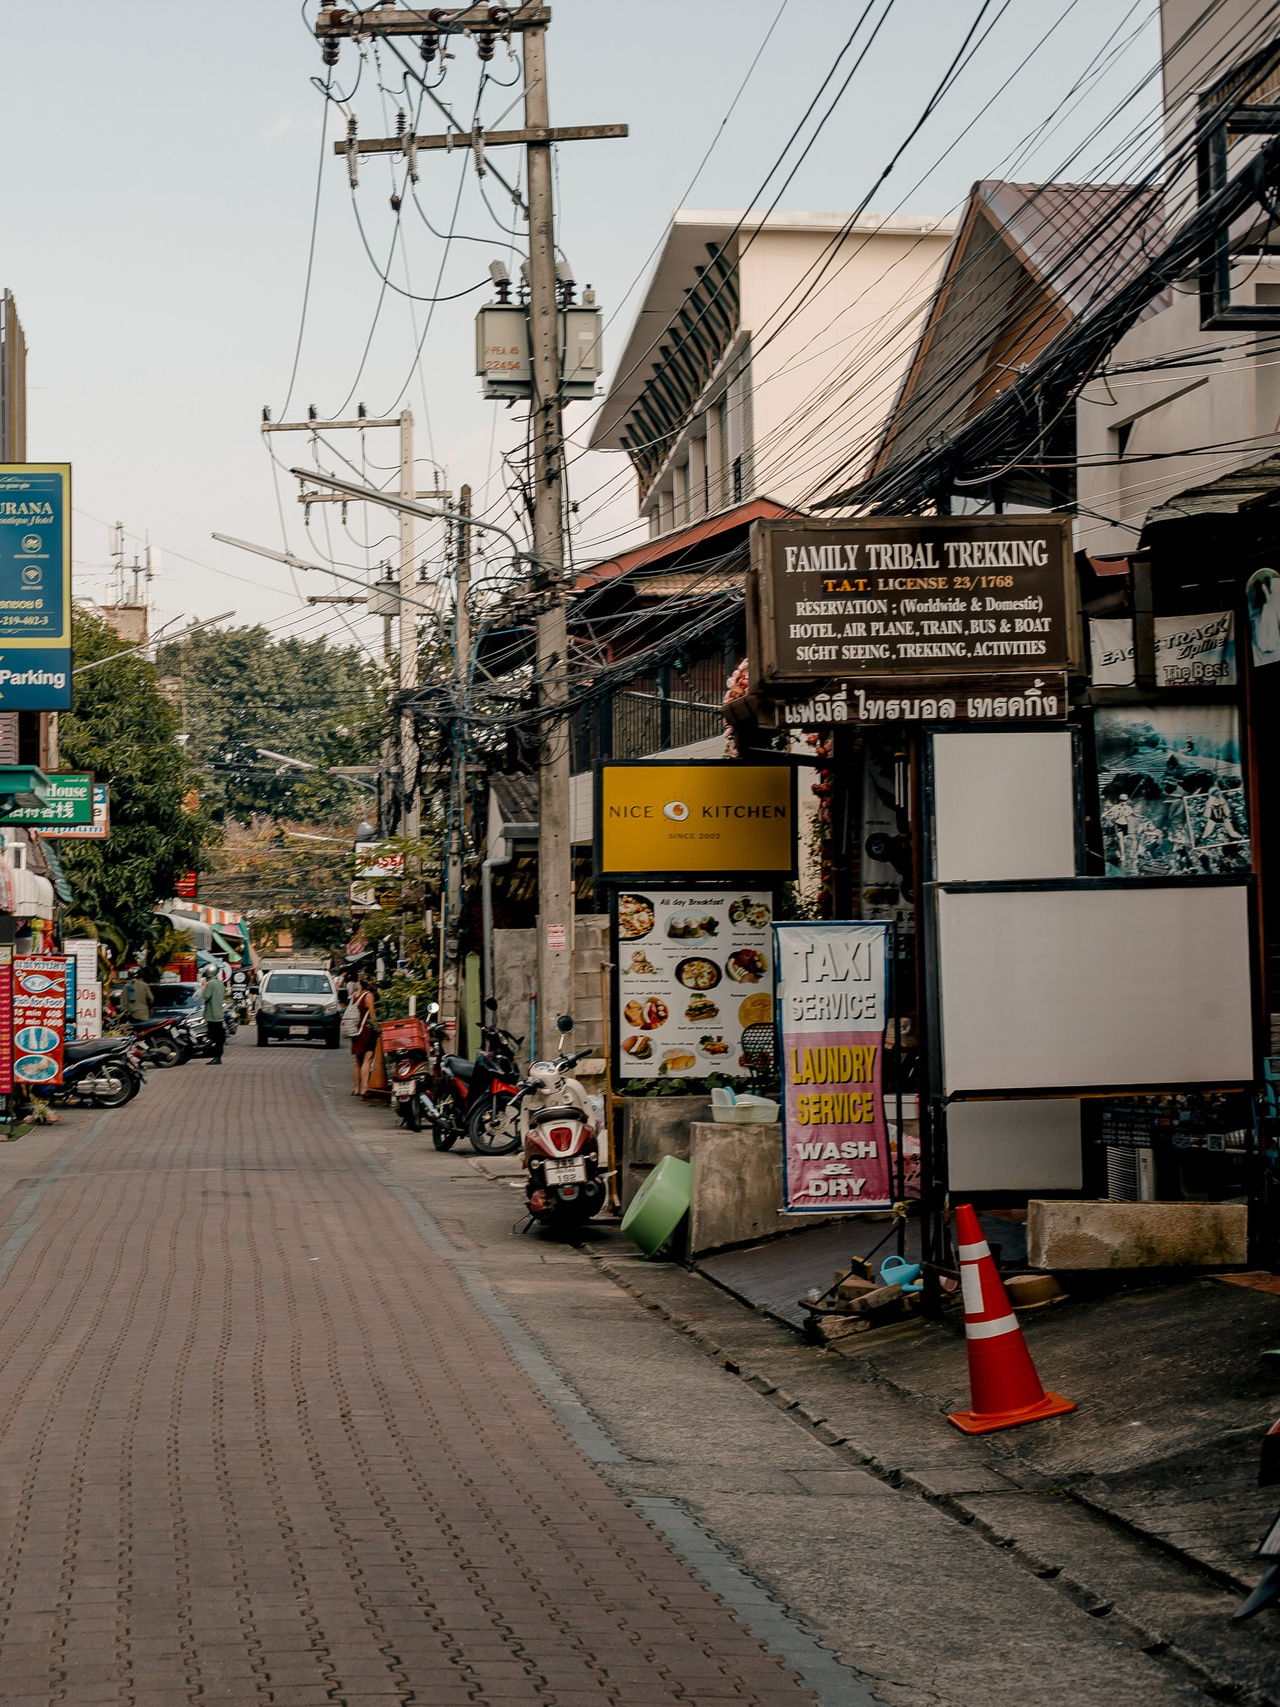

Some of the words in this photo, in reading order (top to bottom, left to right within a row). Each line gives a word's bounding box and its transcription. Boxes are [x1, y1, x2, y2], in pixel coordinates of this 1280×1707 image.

[784, 544, 860, 573] FAMILY
[865, 543, 940, 570] TRIBAL
[943, 539, 1049, 568] TREKKING
[823, 578, 871, 592] T.A.T.
[877, 577, 948, 591] LICENSE
[953, 575, 1014, 591] 23/1768
[796, 599, 888, 616] RESERVATION
[900, 597, 967, 616] (Worldwide
[970, 597, 982, 612] &
[985, 595, 1044, 613] Domestic)
[843, 622, 867, 637] AIR
[969, 619, 997, 634] BUS
[999, 619, 1011, 633] &
[1014, 618, 1052, 633] BOAT
[1164, 618, 1230, 650] TRACK
[796, 645, 839, 661] SIGHT
[973, 640, 1047, 656] ACTIVITIES
[1176, 636, 1227, 660] Zipline
[1163, 664, 1193, 680] The
[1193, 660, 1230, 679] Best
[854, 689, 956, 720] ไทรบอล
[609, 806, 654, 818] NICE
[702, 805, 787, 818] KITCHEN
[793, 941, 872, 983] TAXI
[791, 992, 877, 1021] SERVICE
[791, 1044, 877, 1085] LAUNDRY
[797, 1092, 875, 1125] SERVICE
[796, 1141, 878, 1160] WASH
[821, 1163, 854, 1176] &
[808, 1178, 866, 1197] DRY
